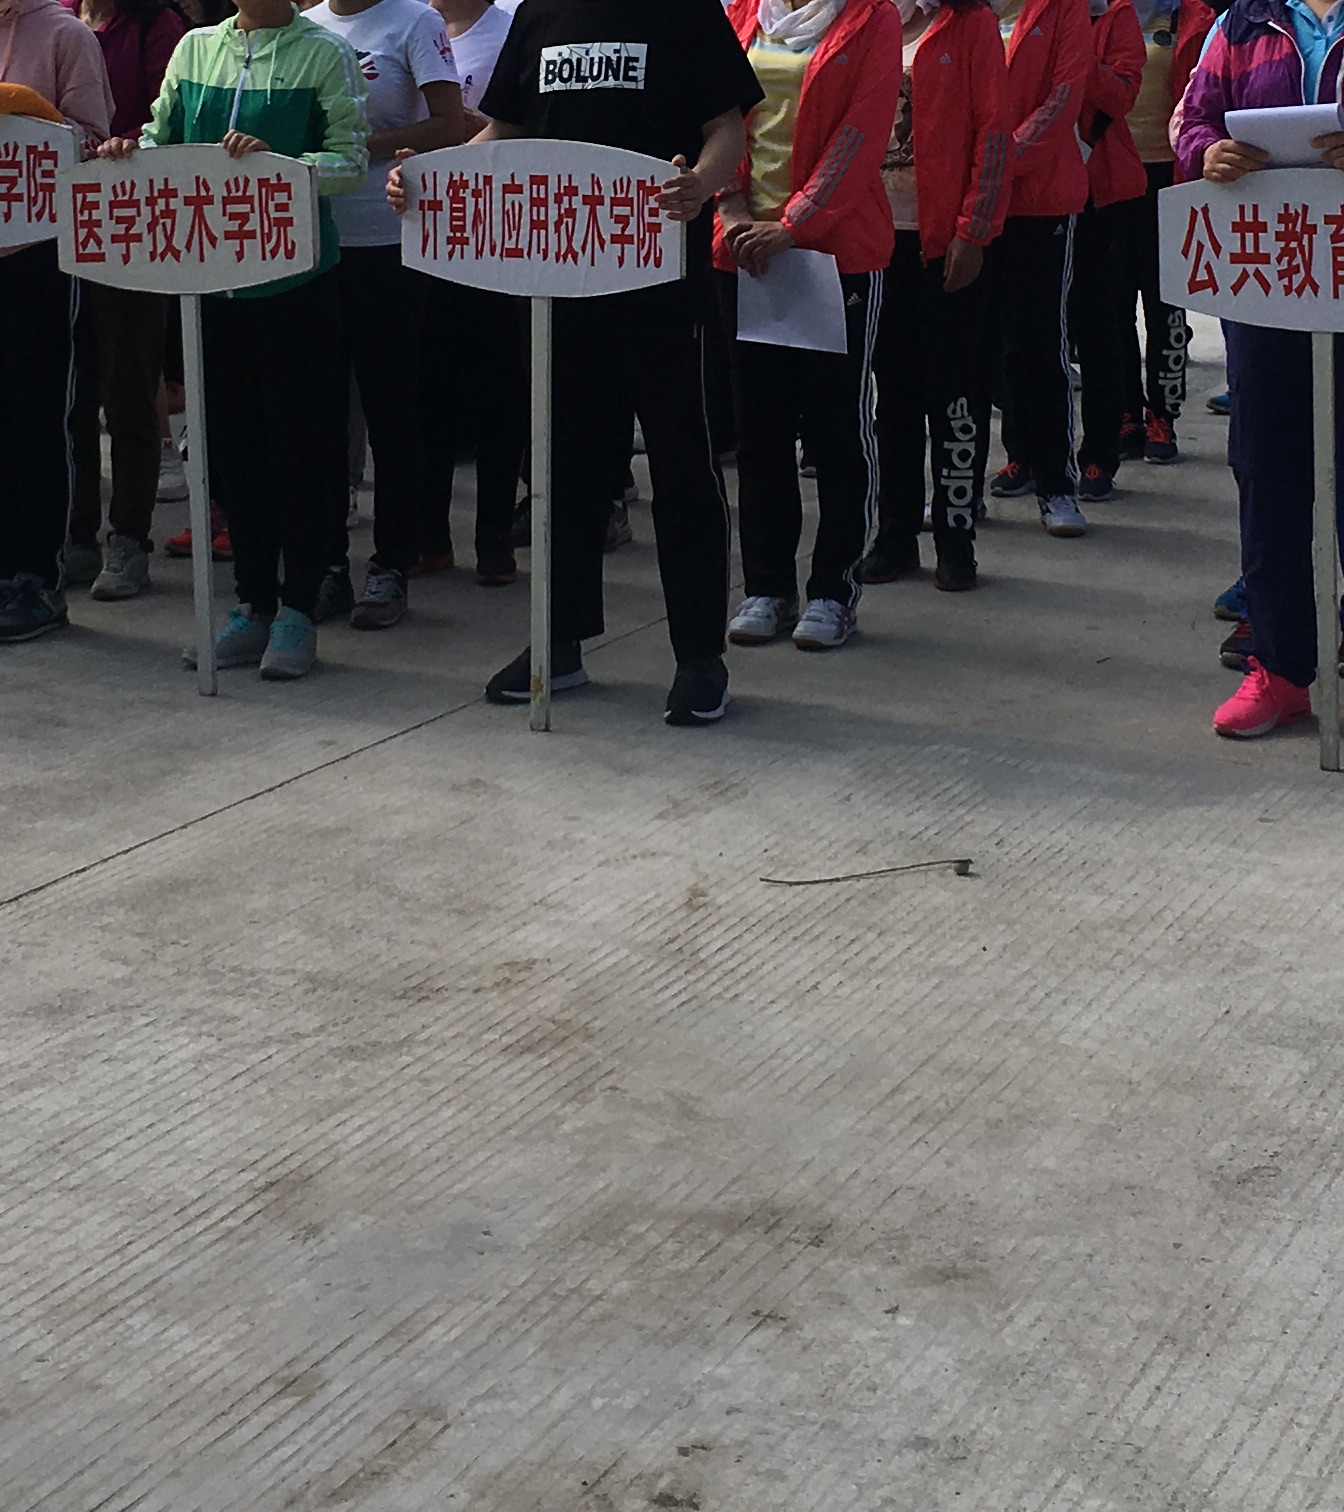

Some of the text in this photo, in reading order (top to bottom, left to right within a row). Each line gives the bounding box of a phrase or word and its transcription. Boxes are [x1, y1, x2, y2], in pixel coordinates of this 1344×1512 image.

[544, 55, 640, 86] BOLUNE
[71, 174, 297, 265] 医学技术学院
[418, 171, 664, 270] 计算机应用技术学院
[941, 396, 977, 530] adidas
